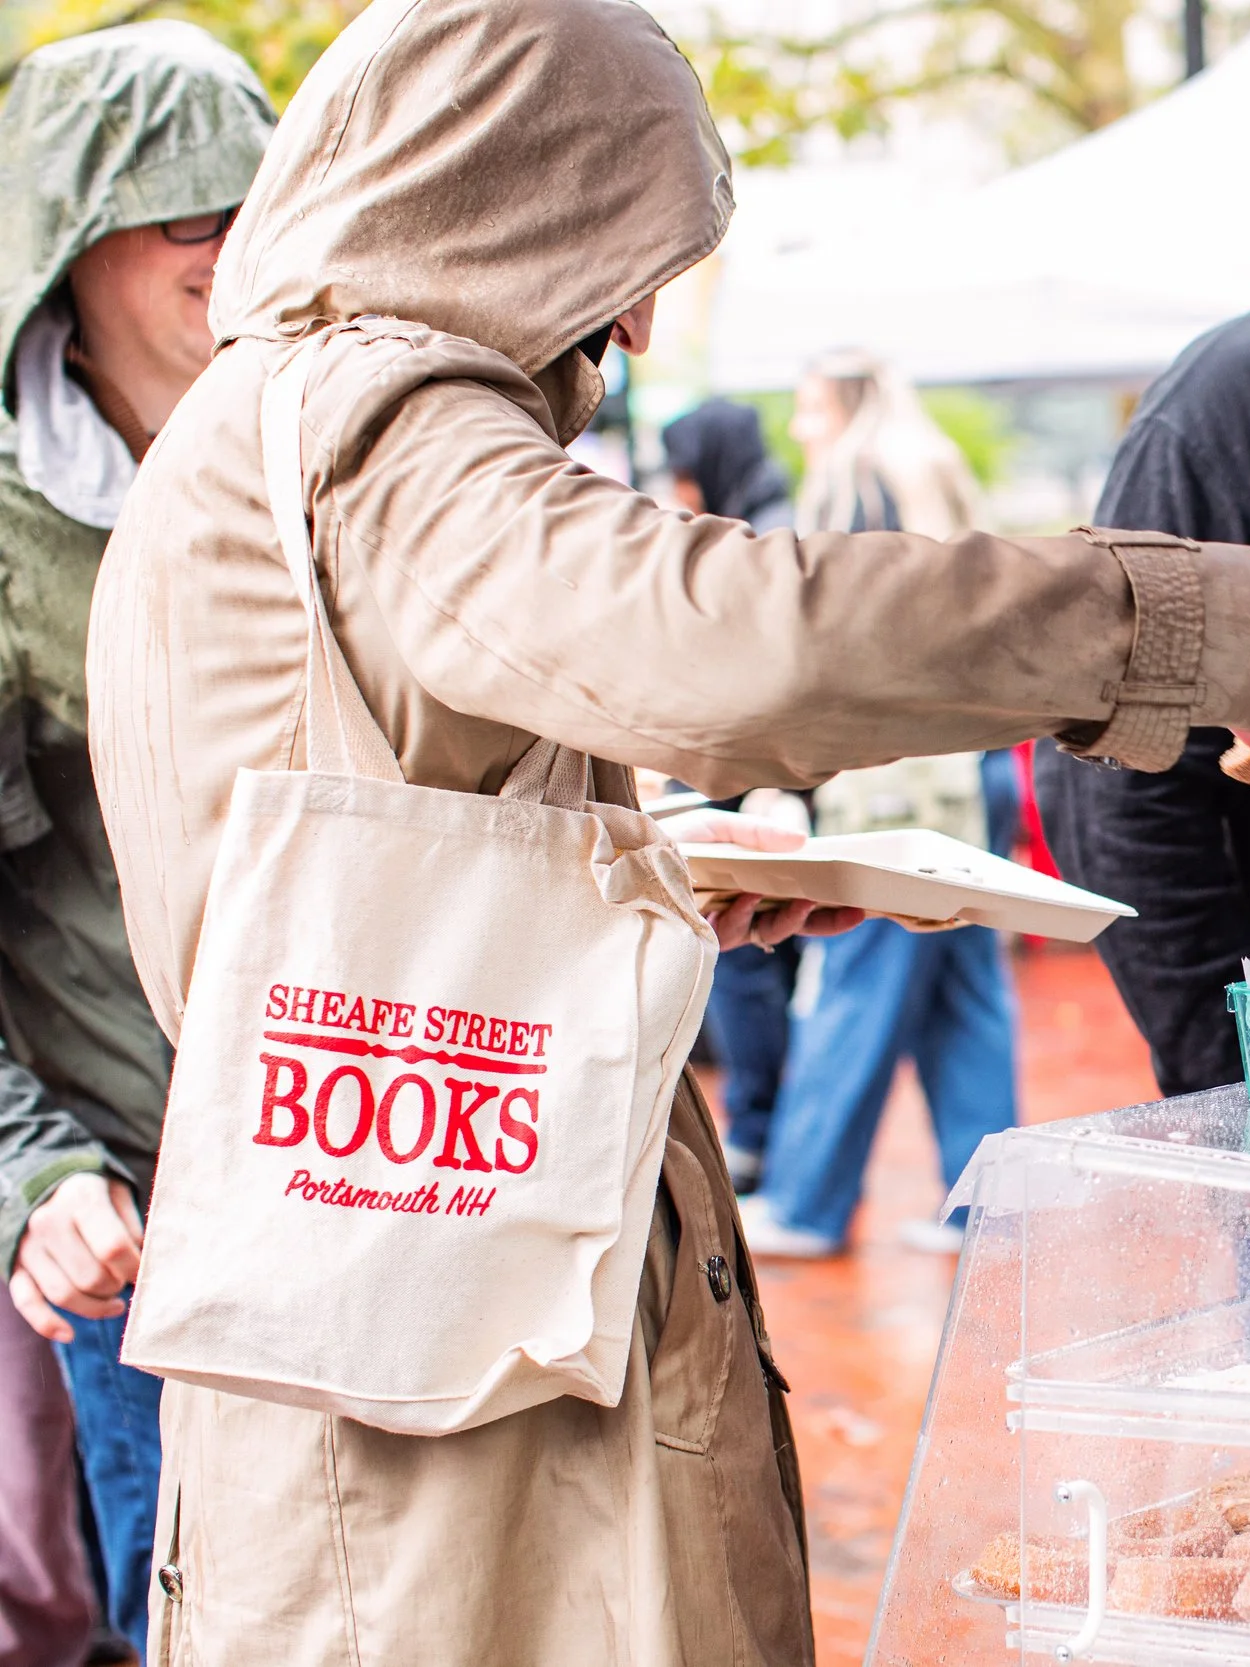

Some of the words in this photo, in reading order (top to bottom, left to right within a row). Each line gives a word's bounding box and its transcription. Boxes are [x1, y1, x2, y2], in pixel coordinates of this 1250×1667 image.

[266, 984, 416, 1038] SHEAFE
[424, 1006, 552, 1057] STREET
[253, 1053, 539, 1174] BOOKS
[285, 1169, 440, 1214] Portsmouth
[446, 1186, 496, 1217] NH
